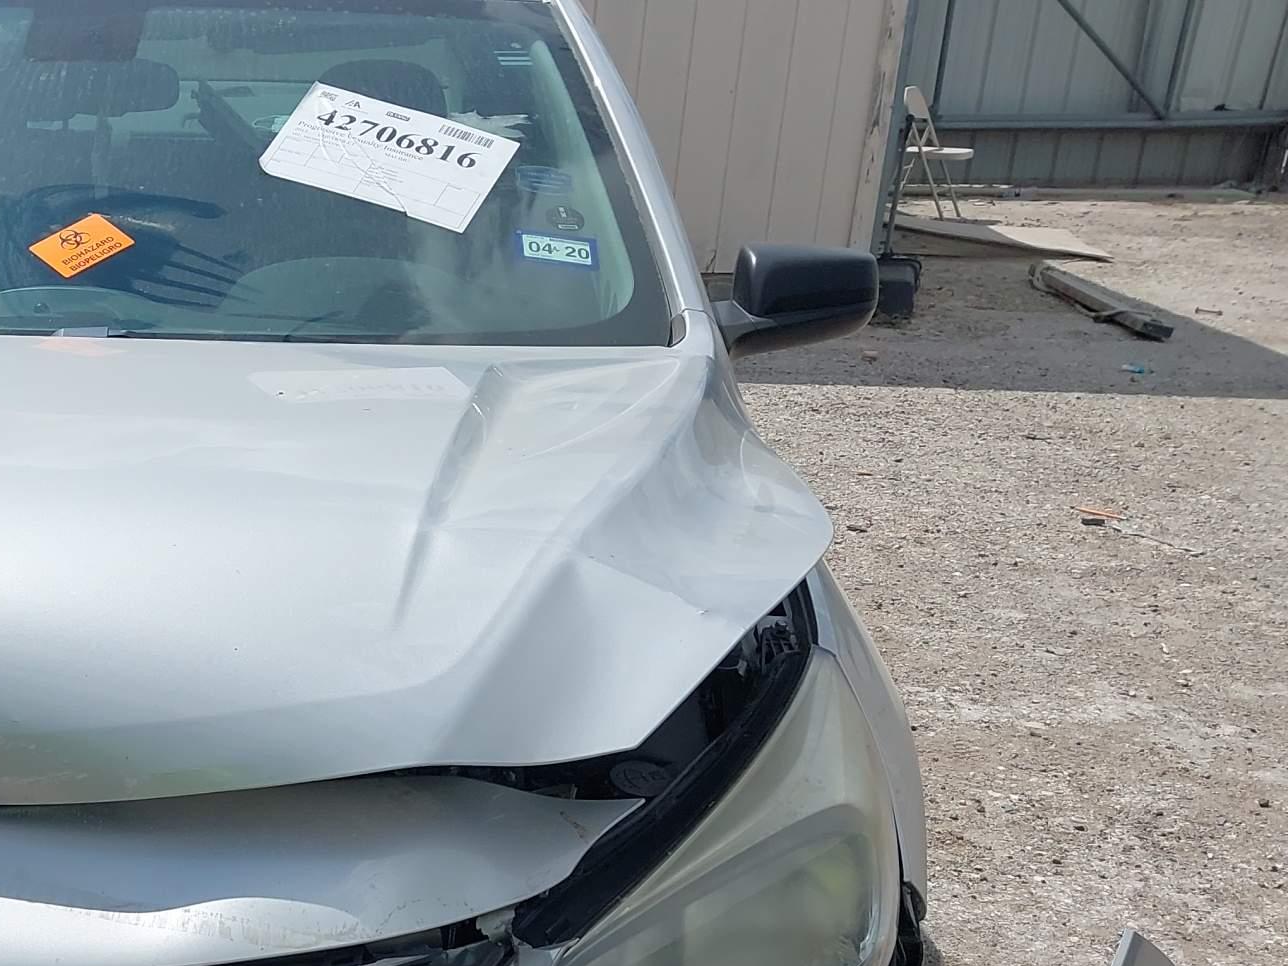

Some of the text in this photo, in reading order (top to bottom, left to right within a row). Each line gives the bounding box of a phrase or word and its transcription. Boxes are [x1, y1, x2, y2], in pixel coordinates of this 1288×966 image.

[317, 109, 483, 169] 42706816
[61, 236, 114, 266] BIOHAZARD
[69, 242, 122, 272] BIOPELIGRO
[528, 241, 590, 260] 04 20
